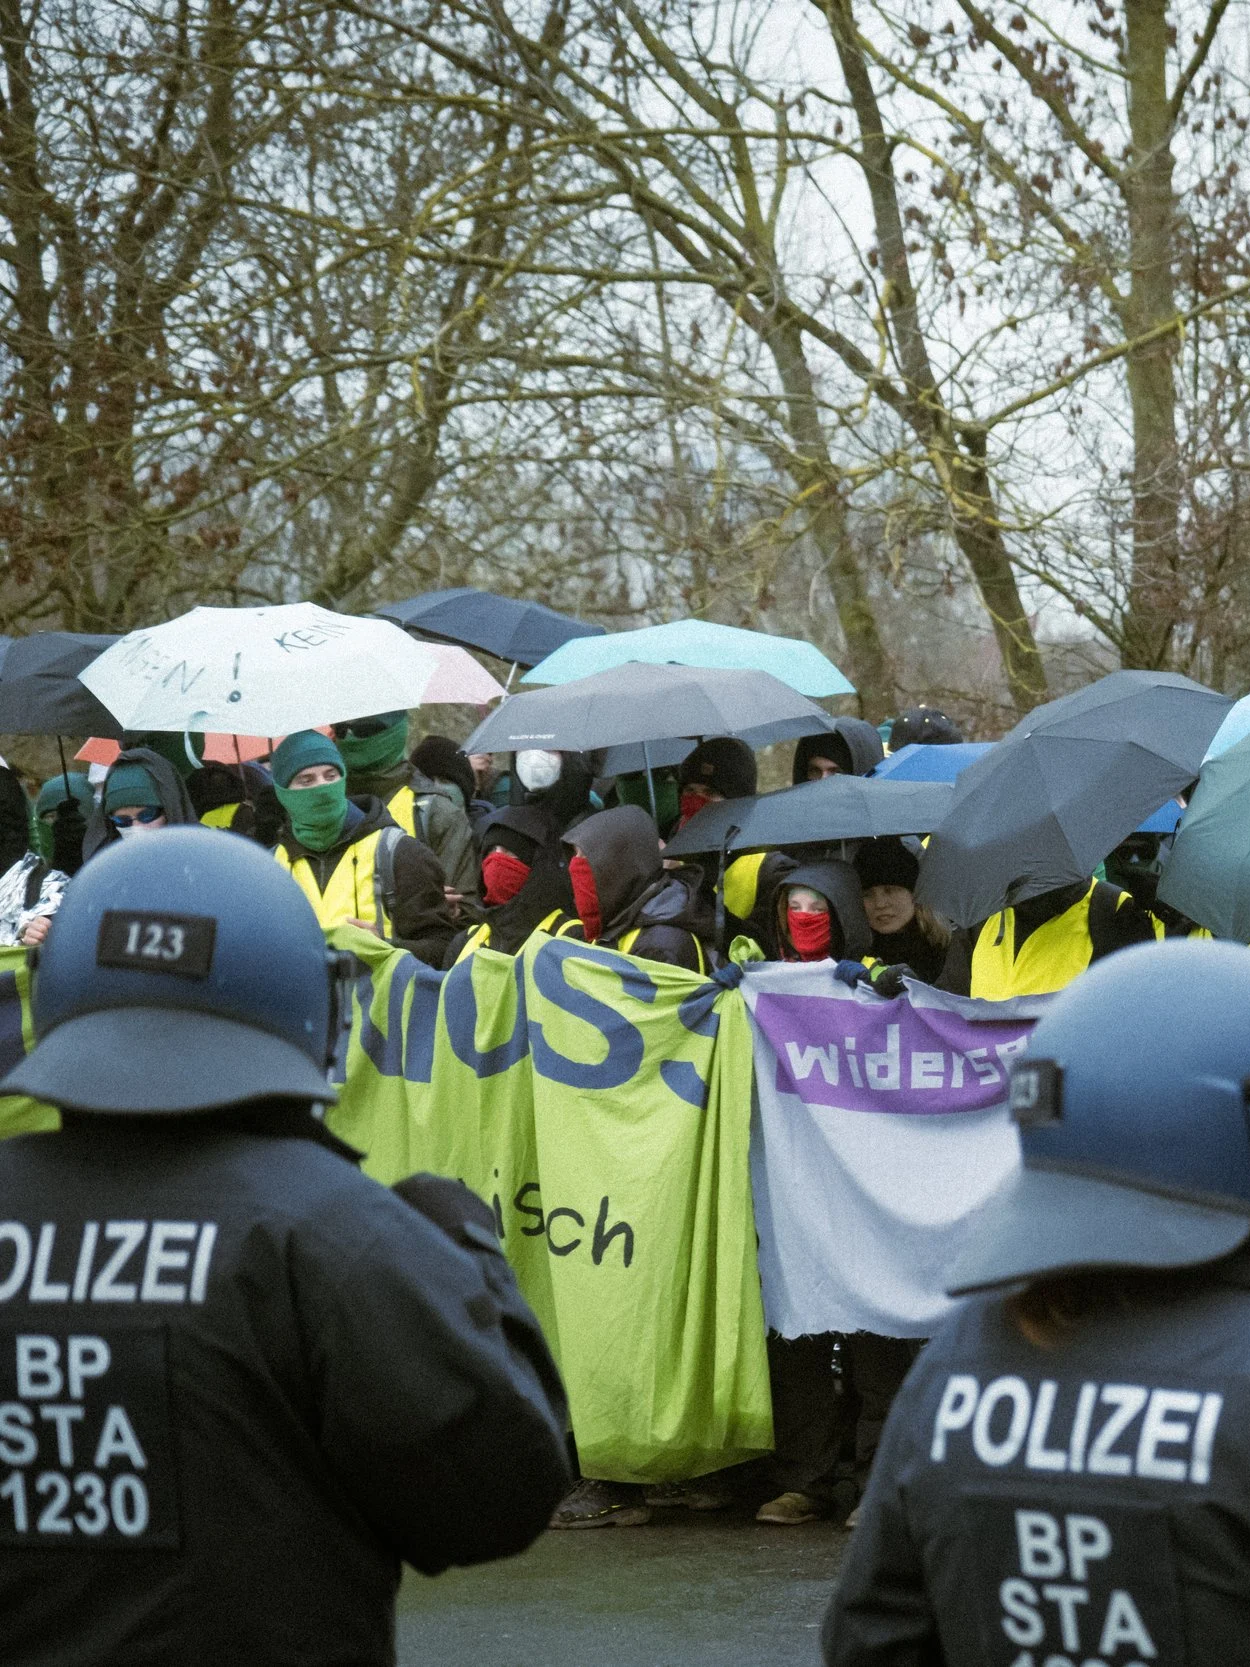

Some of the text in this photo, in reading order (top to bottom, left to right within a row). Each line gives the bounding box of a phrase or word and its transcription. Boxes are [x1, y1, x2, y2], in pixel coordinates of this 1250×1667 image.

[124, 921, 185, 960] 123
[457, 1168, 635, 1268] isch
[15, 1334, 112, 1400] BP
[0, 1402, 148, 1469] STA
[929, 1375, 1224, 1485] POLIZEI
[0, 1470, 150, 1536] 1230
[1013, 1508, 1113, 1581] BP
[999, 1576, 1159, 1659] STA
